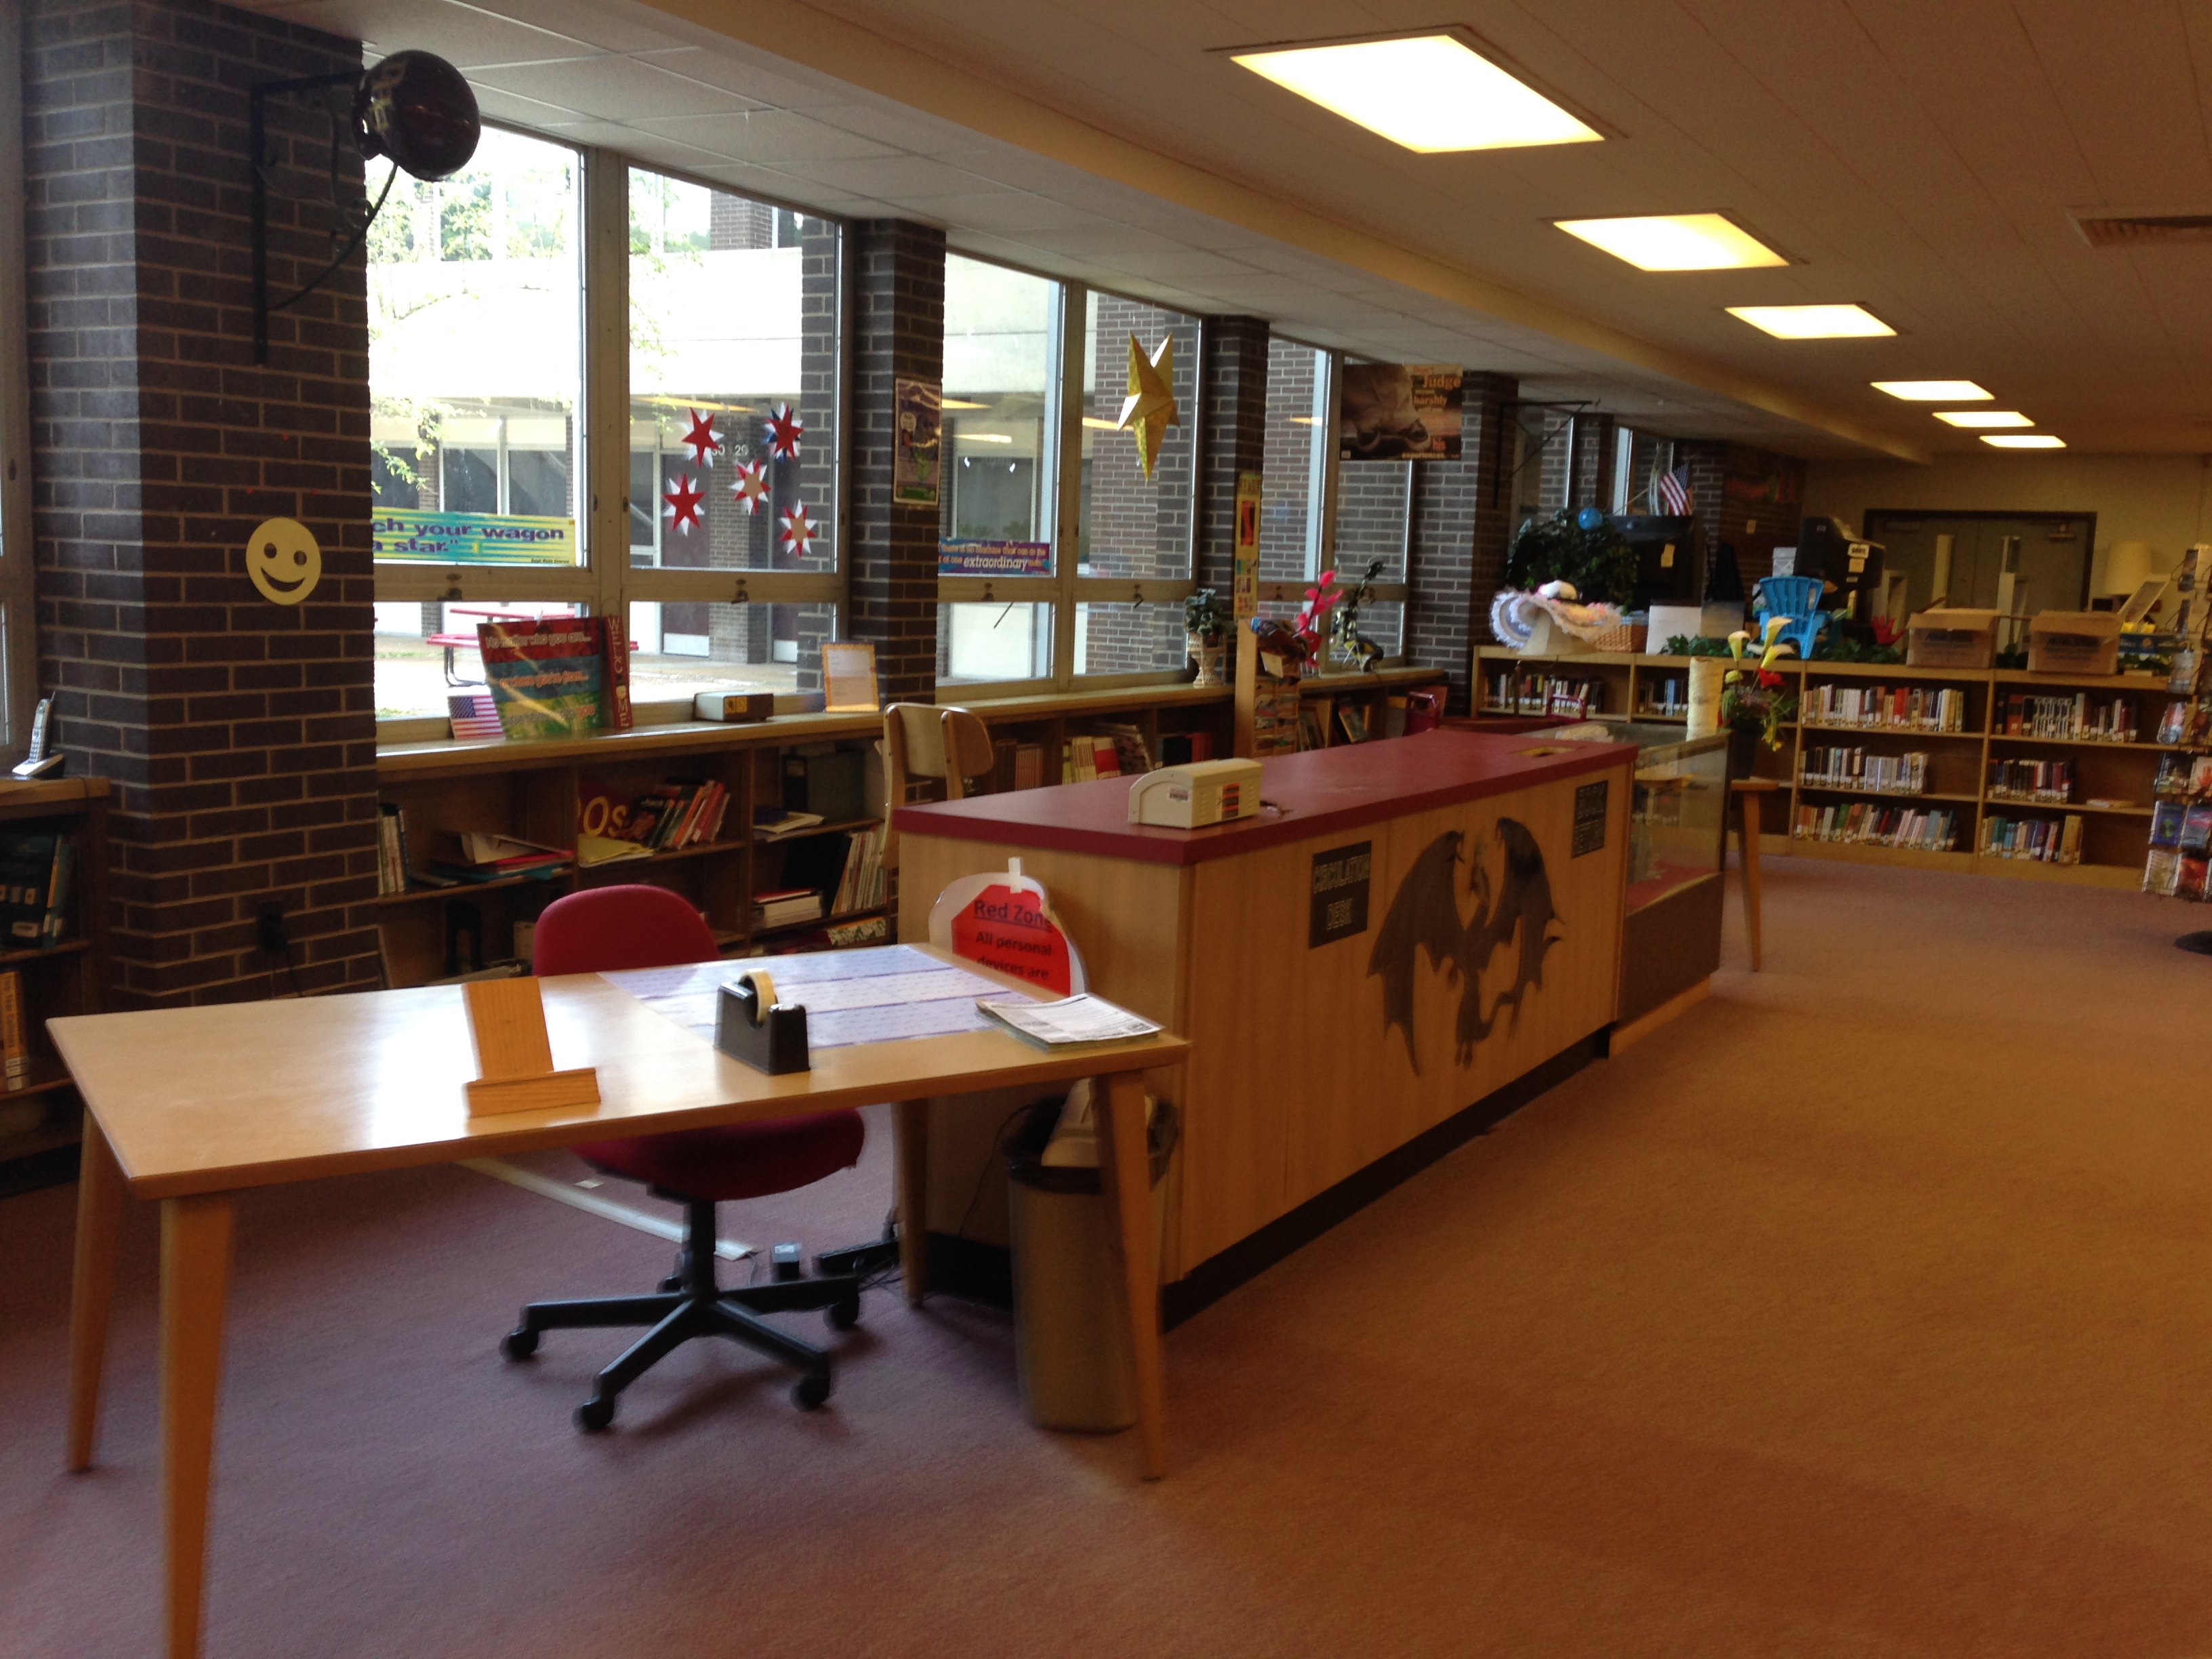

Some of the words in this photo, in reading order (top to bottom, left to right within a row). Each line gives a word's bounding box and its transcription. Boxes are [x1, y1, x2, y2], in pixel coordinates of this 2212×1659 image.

[1422, 374, 1461, 390] Judge
[415, 523, 472, 537] your
[481, 527, 565, 541] wagon
[964, 556, 1027, 571] extraordinary
[529, 632, 548, 646] who
[549, 632, 567, 647] you
[974, 900, 1008, 918] Red
[976, 931, 993, 943] All
[997, 937, 1052, 956] personal
[977, 956, 1024, 976] devices
[1028, 968, 1048, 979] are
